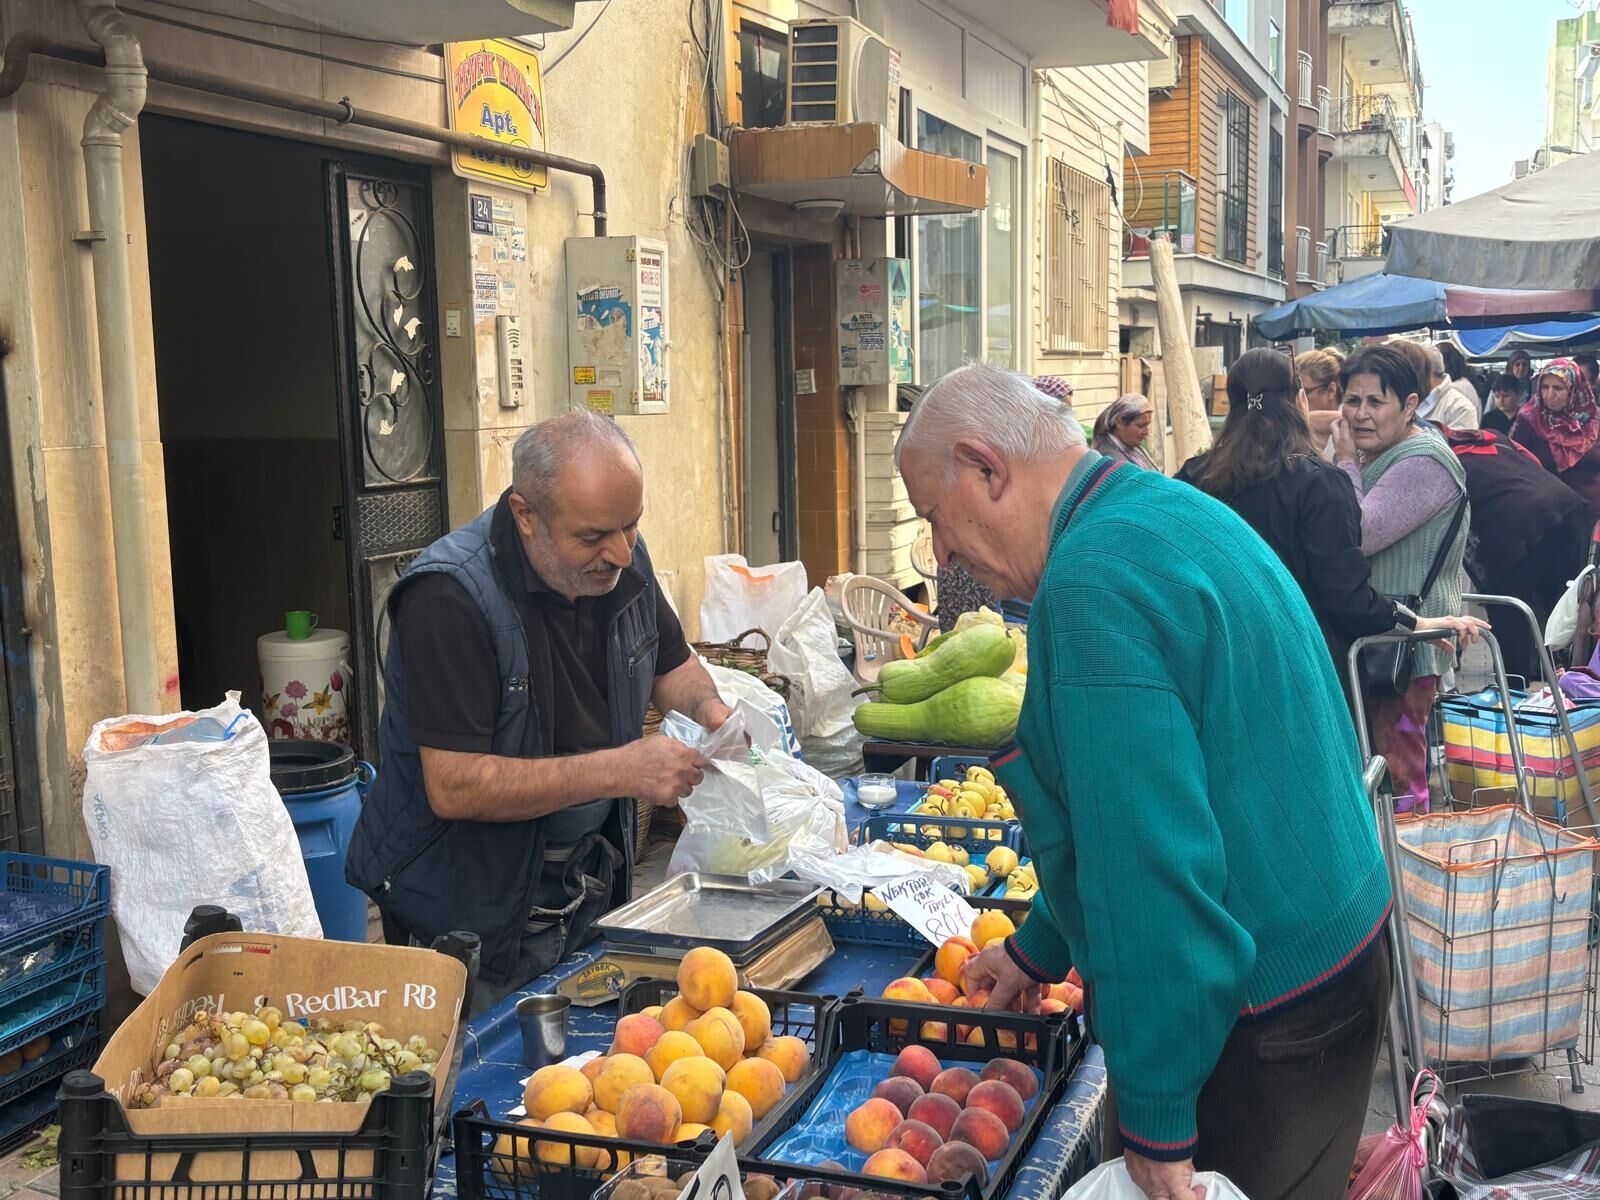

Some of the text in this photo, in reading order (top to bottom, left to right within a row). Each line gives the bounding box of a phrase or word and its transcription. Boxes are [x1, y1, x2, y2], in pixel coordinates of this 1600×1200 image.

[480, 103, 518, 136] Apt.
[477, 200, 489, 220] 24
[881, 876, 930, 904] NEKTAR
[286, 985, 388, 1017] RedBar
[403, 983, 437, 1009] RB
